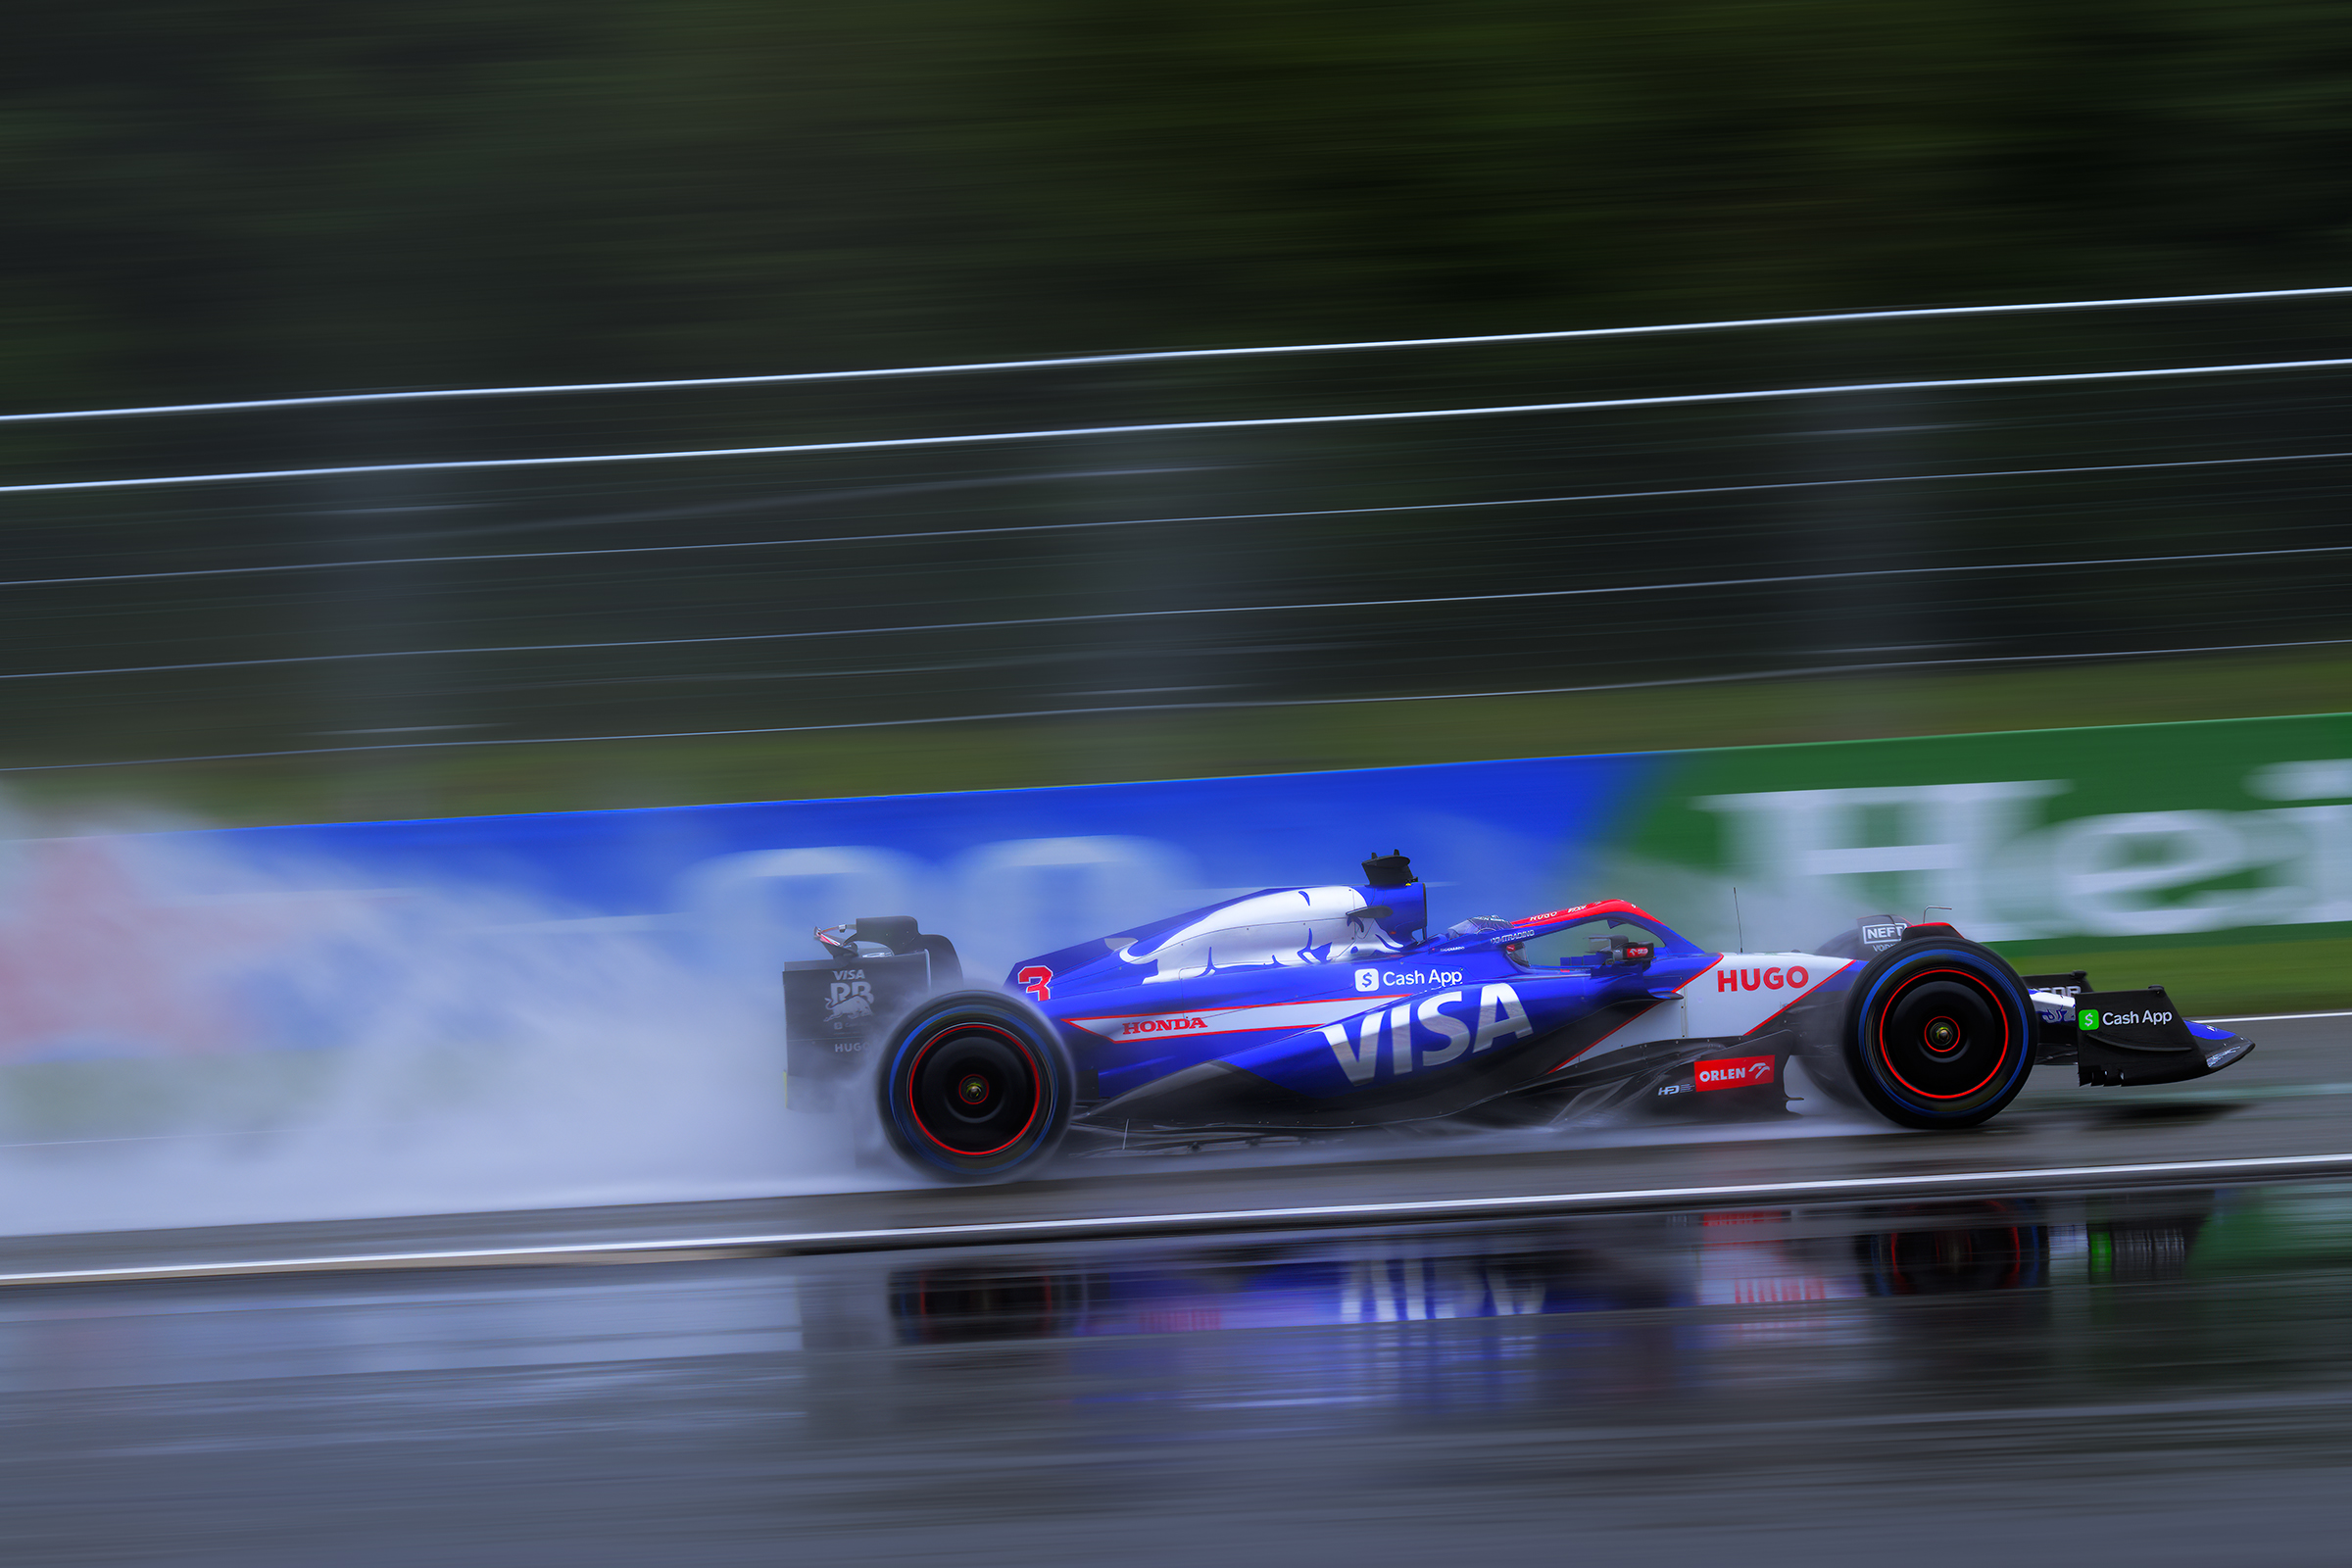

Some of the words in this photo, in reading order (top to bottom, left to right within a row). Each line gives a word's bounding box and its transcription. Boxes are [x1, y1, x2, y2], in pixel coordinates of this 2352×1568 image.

[1867, 926, 1903, 939] NEFT
[832, 969, 865, 980] VISA
[1017, 965, 1054, 1002] 3
[1383, 970, 1425, 986] Cash
[1428, 969, 1463, 987] App
[1717, 965, 1809, 993] HUGO
[1122, 1017, 1208, 1035] HONDA
[2102, 1010, 2139, 1026] Cash
[2141, 1009, 2173, 1025] App
[1321, 982, 1534, 1087] VISA
[1699, 1067, 1746, 1082] ORLEN
